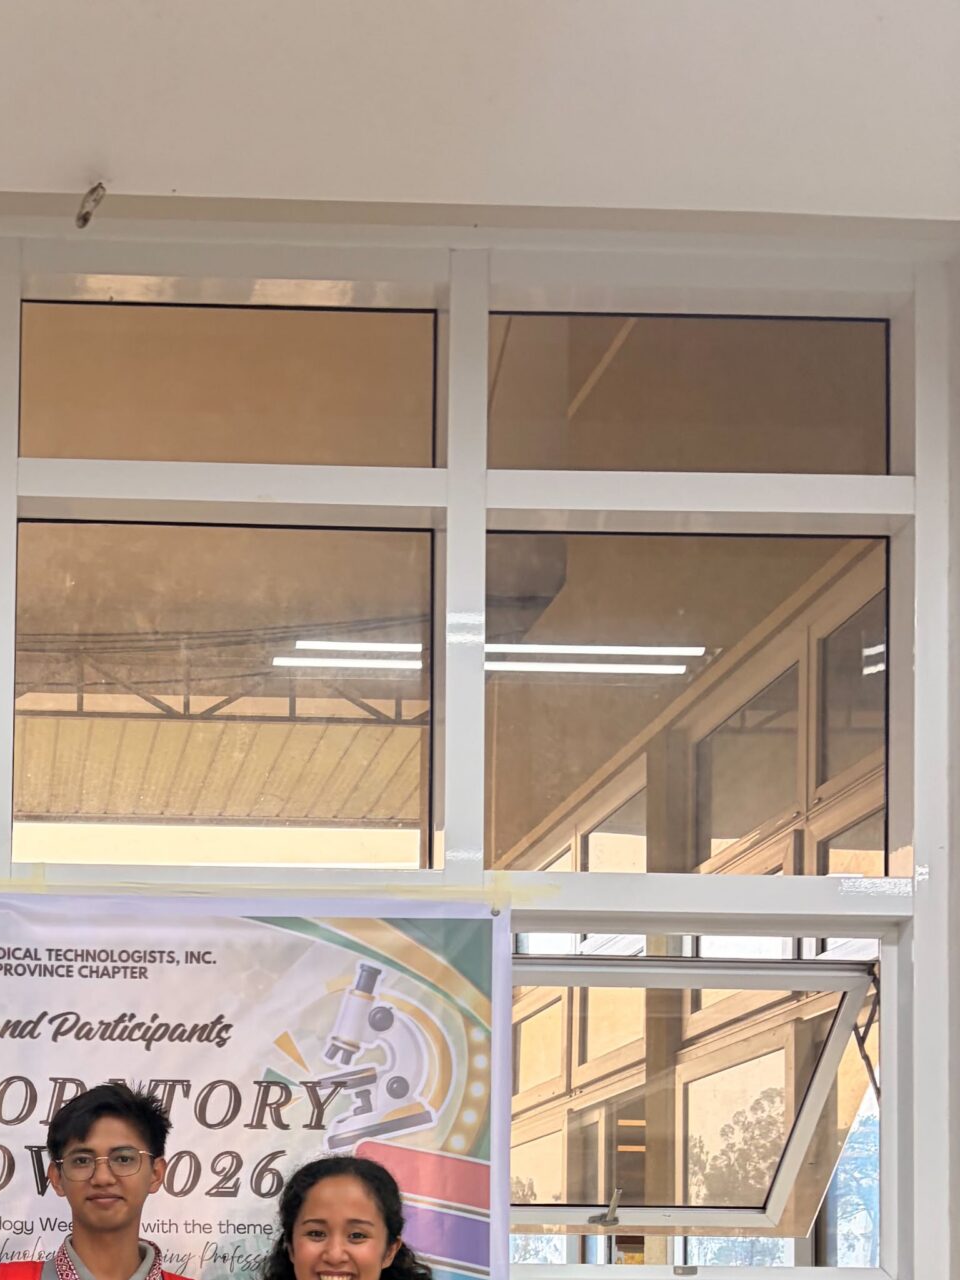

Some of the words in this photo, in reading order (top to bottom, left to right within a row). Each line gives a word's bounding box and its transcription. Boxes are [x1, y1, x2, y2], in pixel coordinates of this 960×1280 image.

[45, 948, 180, 966] TECHNOLOGISTS,
[184, 950, 218, 965] INC.
[78, 964, 149, 980] CHAPTER
[47, 1011, 234, 1052] Participants
[162, 1150, 287, 1199] 026
[40, 1216, 73, 1232] Wee
[142, 1218, 179, 1235] with
[183, 1219, 213, 1235] the
[218, 1219, 274, 1236] theme
